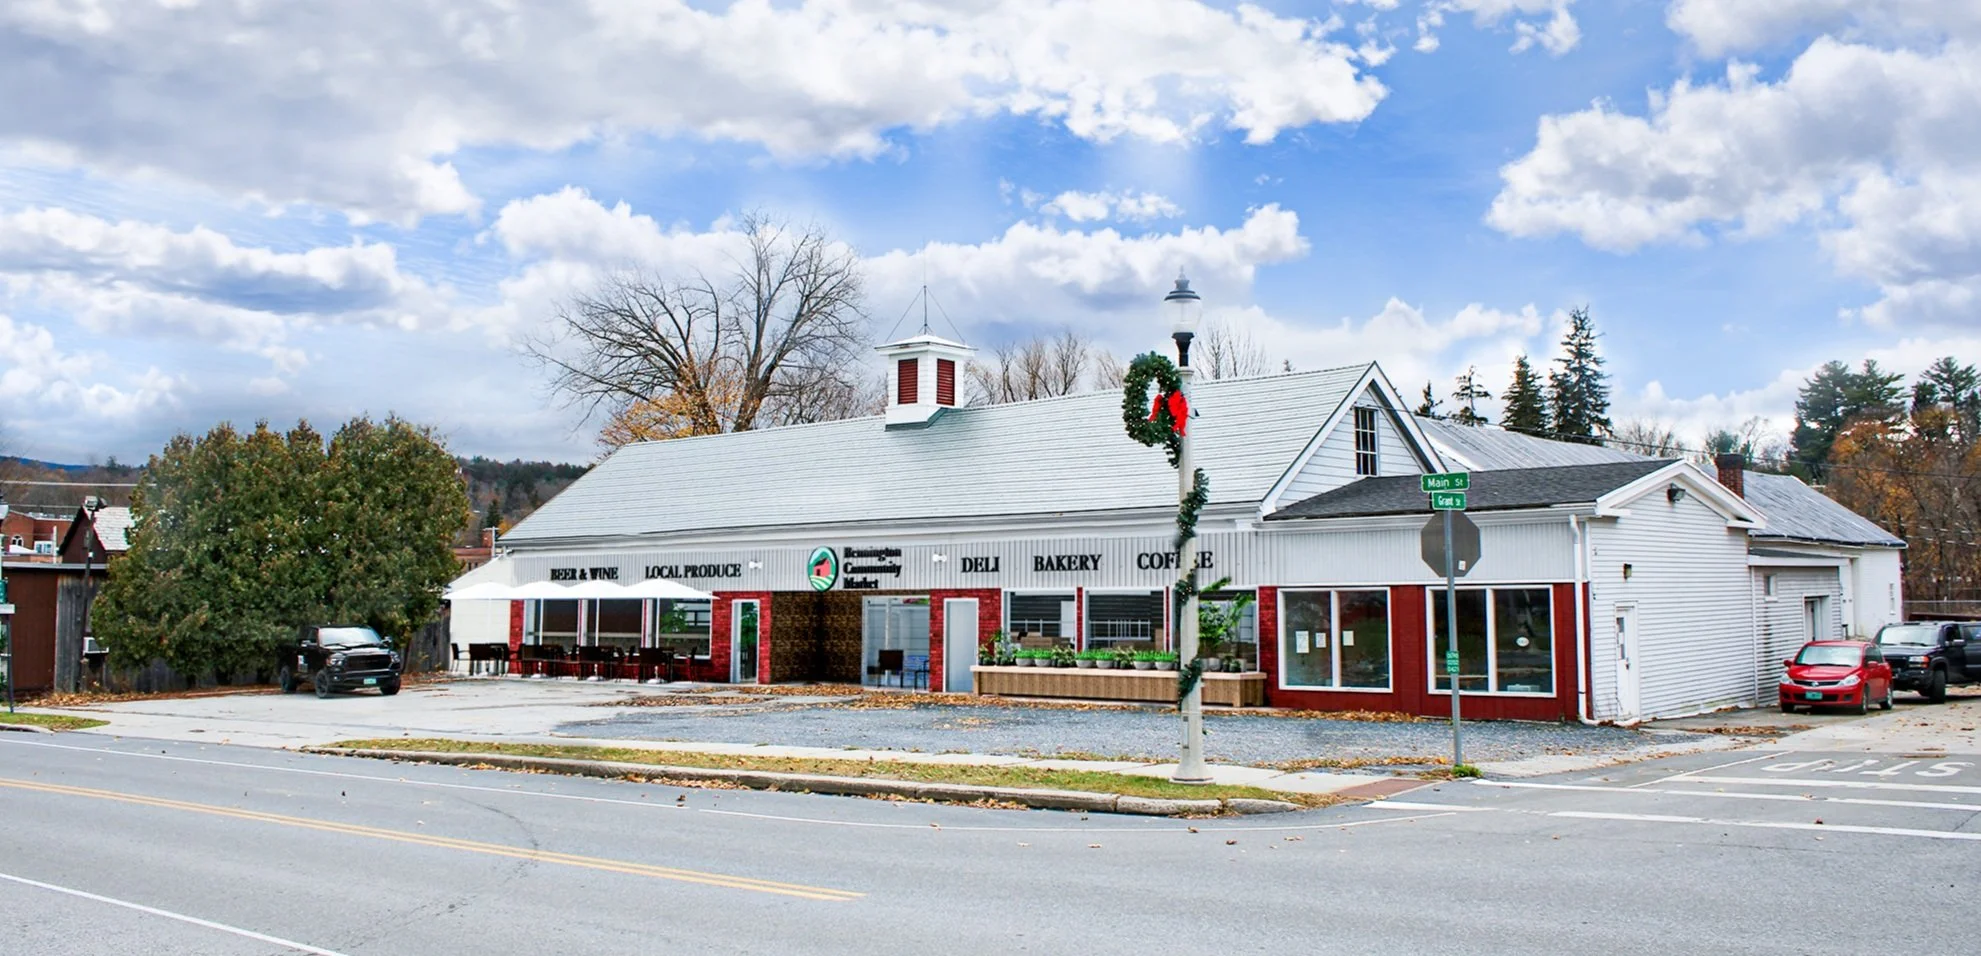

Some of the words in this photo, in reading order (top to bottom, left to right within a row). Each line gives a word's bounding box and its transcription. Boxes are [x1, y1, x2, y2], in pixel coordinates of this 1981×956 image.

[1427, 476, 1450, 488] Main
[1454, 477, 1464, 487] St
[960, 556, 1000, 573] DELI
[1032, 554, 1103, 571] BAKERY
[1136, 551, 1214, 570] COFE
[550, 568, 578, 581] BEER
[578, 568, 588, 580] &
[589, 567, 619, 580] WINE
[645, 565, 682, 579] LOCAL
[683, 564, 742, 578] PRODUCE
[843, 562, 902, 578] Community
[843, 577, 879, 589] Market
